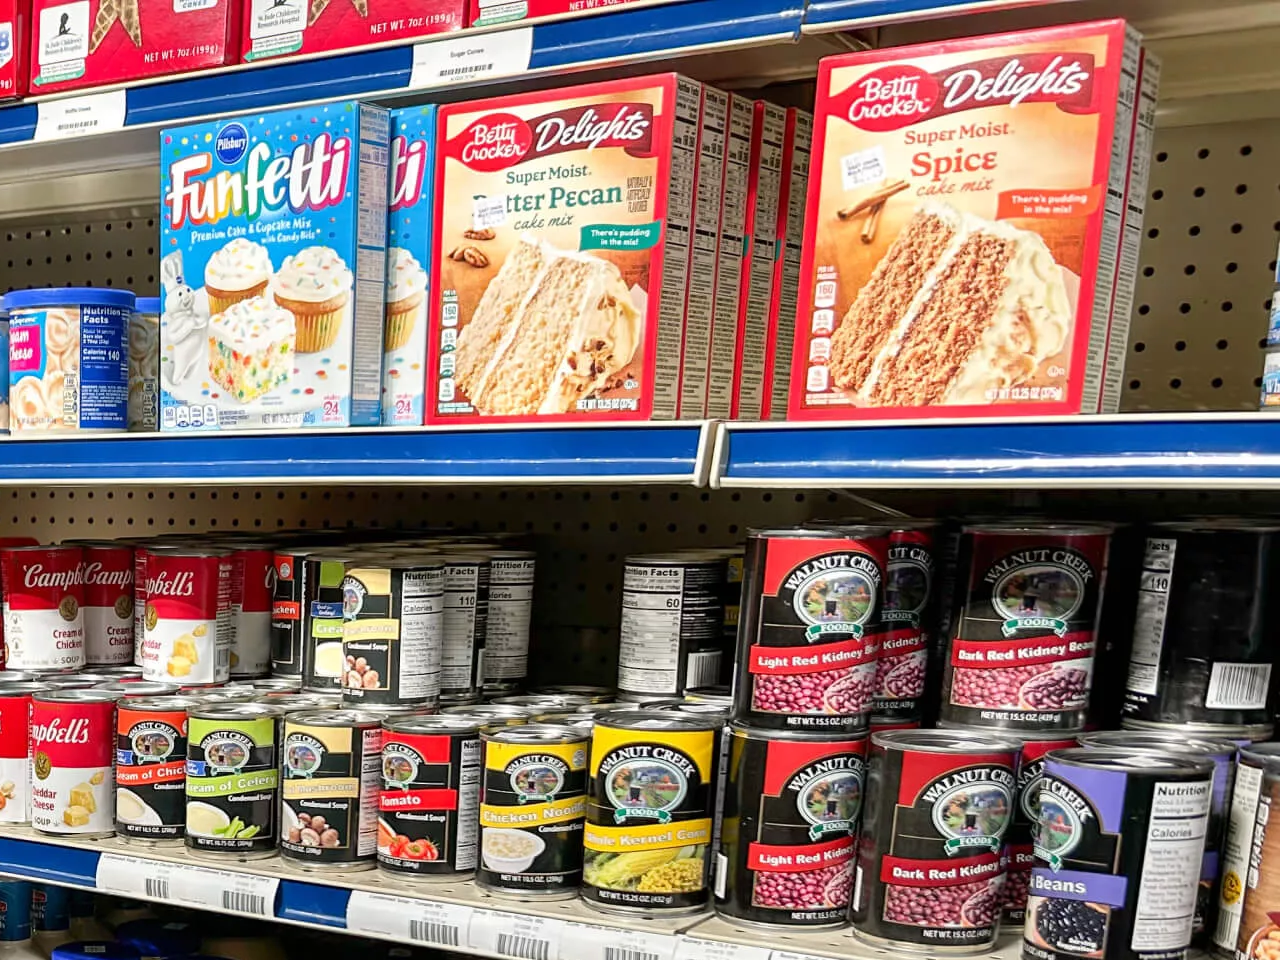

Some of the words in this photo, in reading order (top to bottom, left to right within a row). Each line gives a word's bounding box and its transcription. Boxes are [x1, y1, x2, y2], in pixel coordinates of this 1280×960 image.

[861, 75, 921, 101] Betty
[943, 56, 1089, 110] Delights
[848, 96, 926, 123] Crocker
[473, 124, 517, 145] Betty
[536, 108, 649, 151] Delights
[903, 127, 955, 147] Super
[960, 122, 1010, 139] Moist
[217, 138, 246, 151] Pillsbury
[462, 141, 524, 163] Crocker
[910, 147, 998, 181] Spice
[166, 132, 352, 229] Funfetti
[506, 169, 546, 185] Super
[548, 164, 588, 180] Moist
[916, 180, 955, 197] cake
[960, 177, 995, 192] mix
[549, 186, 622, 209] Pecan
[1012, 195, 1045, 204] There's
[1047, 194, 1087, 206] pudding
[514, 215, 544, 231] cake
[548, 212, 573, 226] mix
[191, 228, 226, 243] Premium
[227, 226, 246, 237] Cake
[249, 224, 254, 233] &
[256, 221, 291, 233] Cupcake
[293, 219, 311, 229] Mix
[83, 307, 120, 316] Nutrition
[83, 315, 108, 324] Facts
[323, 402, 340, 415] 24
[395, 401, 412, 415] 24
[1018, 619, 1056, 627] FOODS
[758, 655, 788, 668] Light
[792, 654, 818, 666] Red
[822, 648, 863, 664] Kidney
[958, 649, 984, 661] Dark
[987, 649, 1014, 660] Red
[1018, 645, 1066, 660] Kidney
[1158, 784, 1206, 797] Nutrition
[381, 795, 421, 807] Tomato
[484, 810, 537, 823] Chicken
[619, 830, 672, 845] Kernel
[676, 827, 706, 842] Corn
[1152, 829, 1192, 839] Calories
[759, 854, 793, 866] Light
[796, 853, 820, 864] Red
[893, 868, 924, 880] Dark
[929, 868, 956, 879] Red
[960, 862, 998, 877] Kidney
[1036, 877, 1086, 895] Beans
